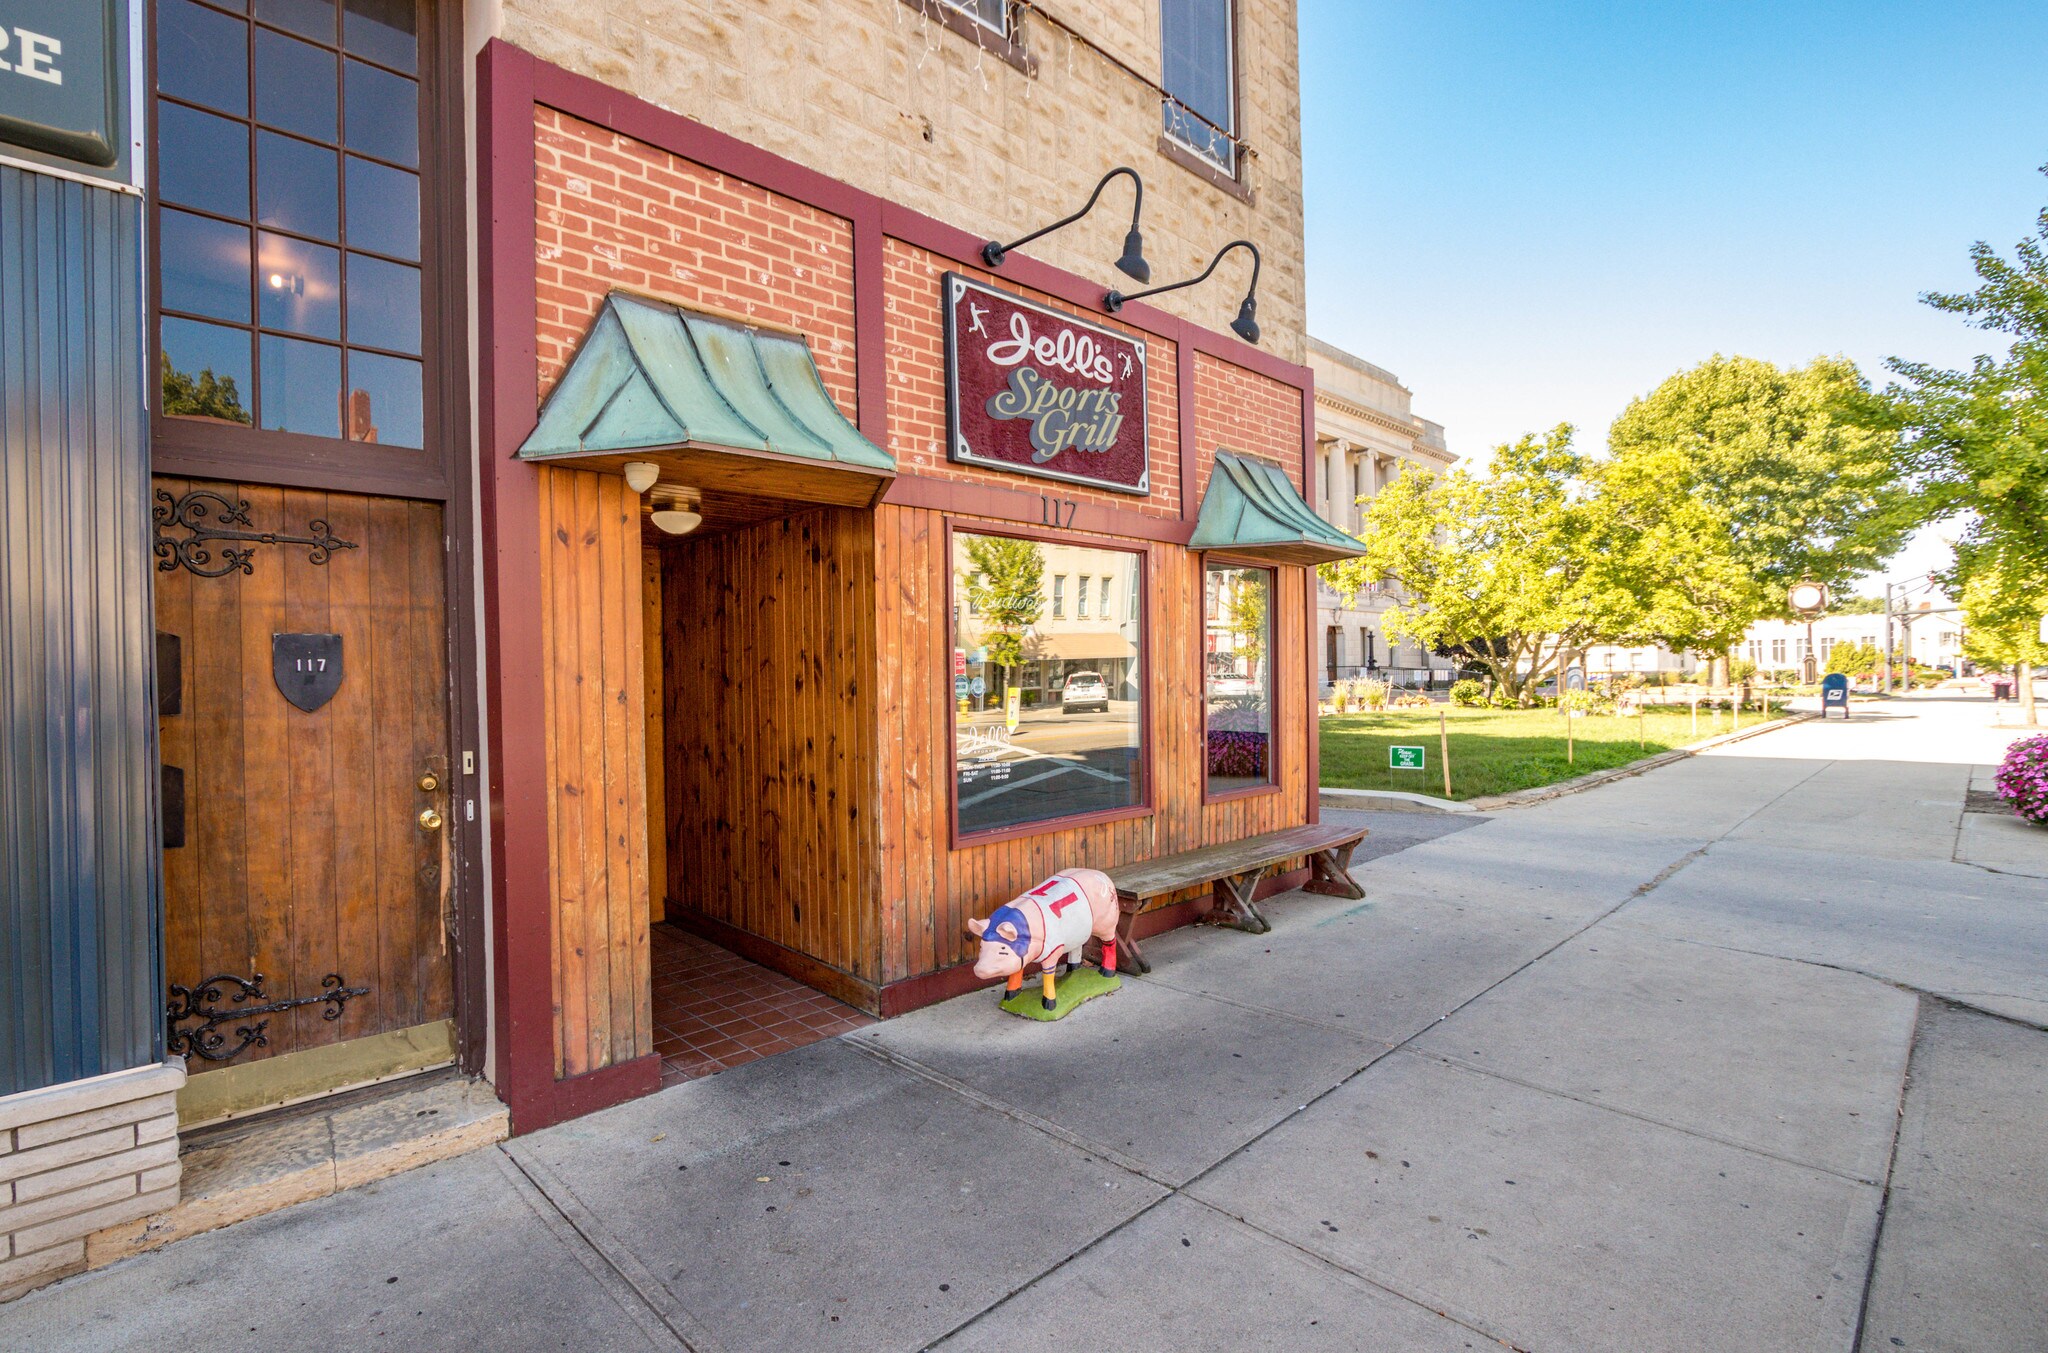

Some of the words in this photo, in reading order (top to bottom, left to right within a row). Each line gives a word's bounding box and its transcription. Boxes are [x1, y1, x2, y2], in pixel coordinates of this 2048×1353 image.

[0, 25, 62, 86] E
[987, 312, 1113, 384] Jell's
[994, 366, 1123, 415] Sports
[1037, 408, 1123, 457] Grill
[1040, 495, 1077, 530] 117
[968, 585, 1062, 610] Budweir
[296, 658, 327, 672] 117
[960, 725, 1010, 755] Jell's
